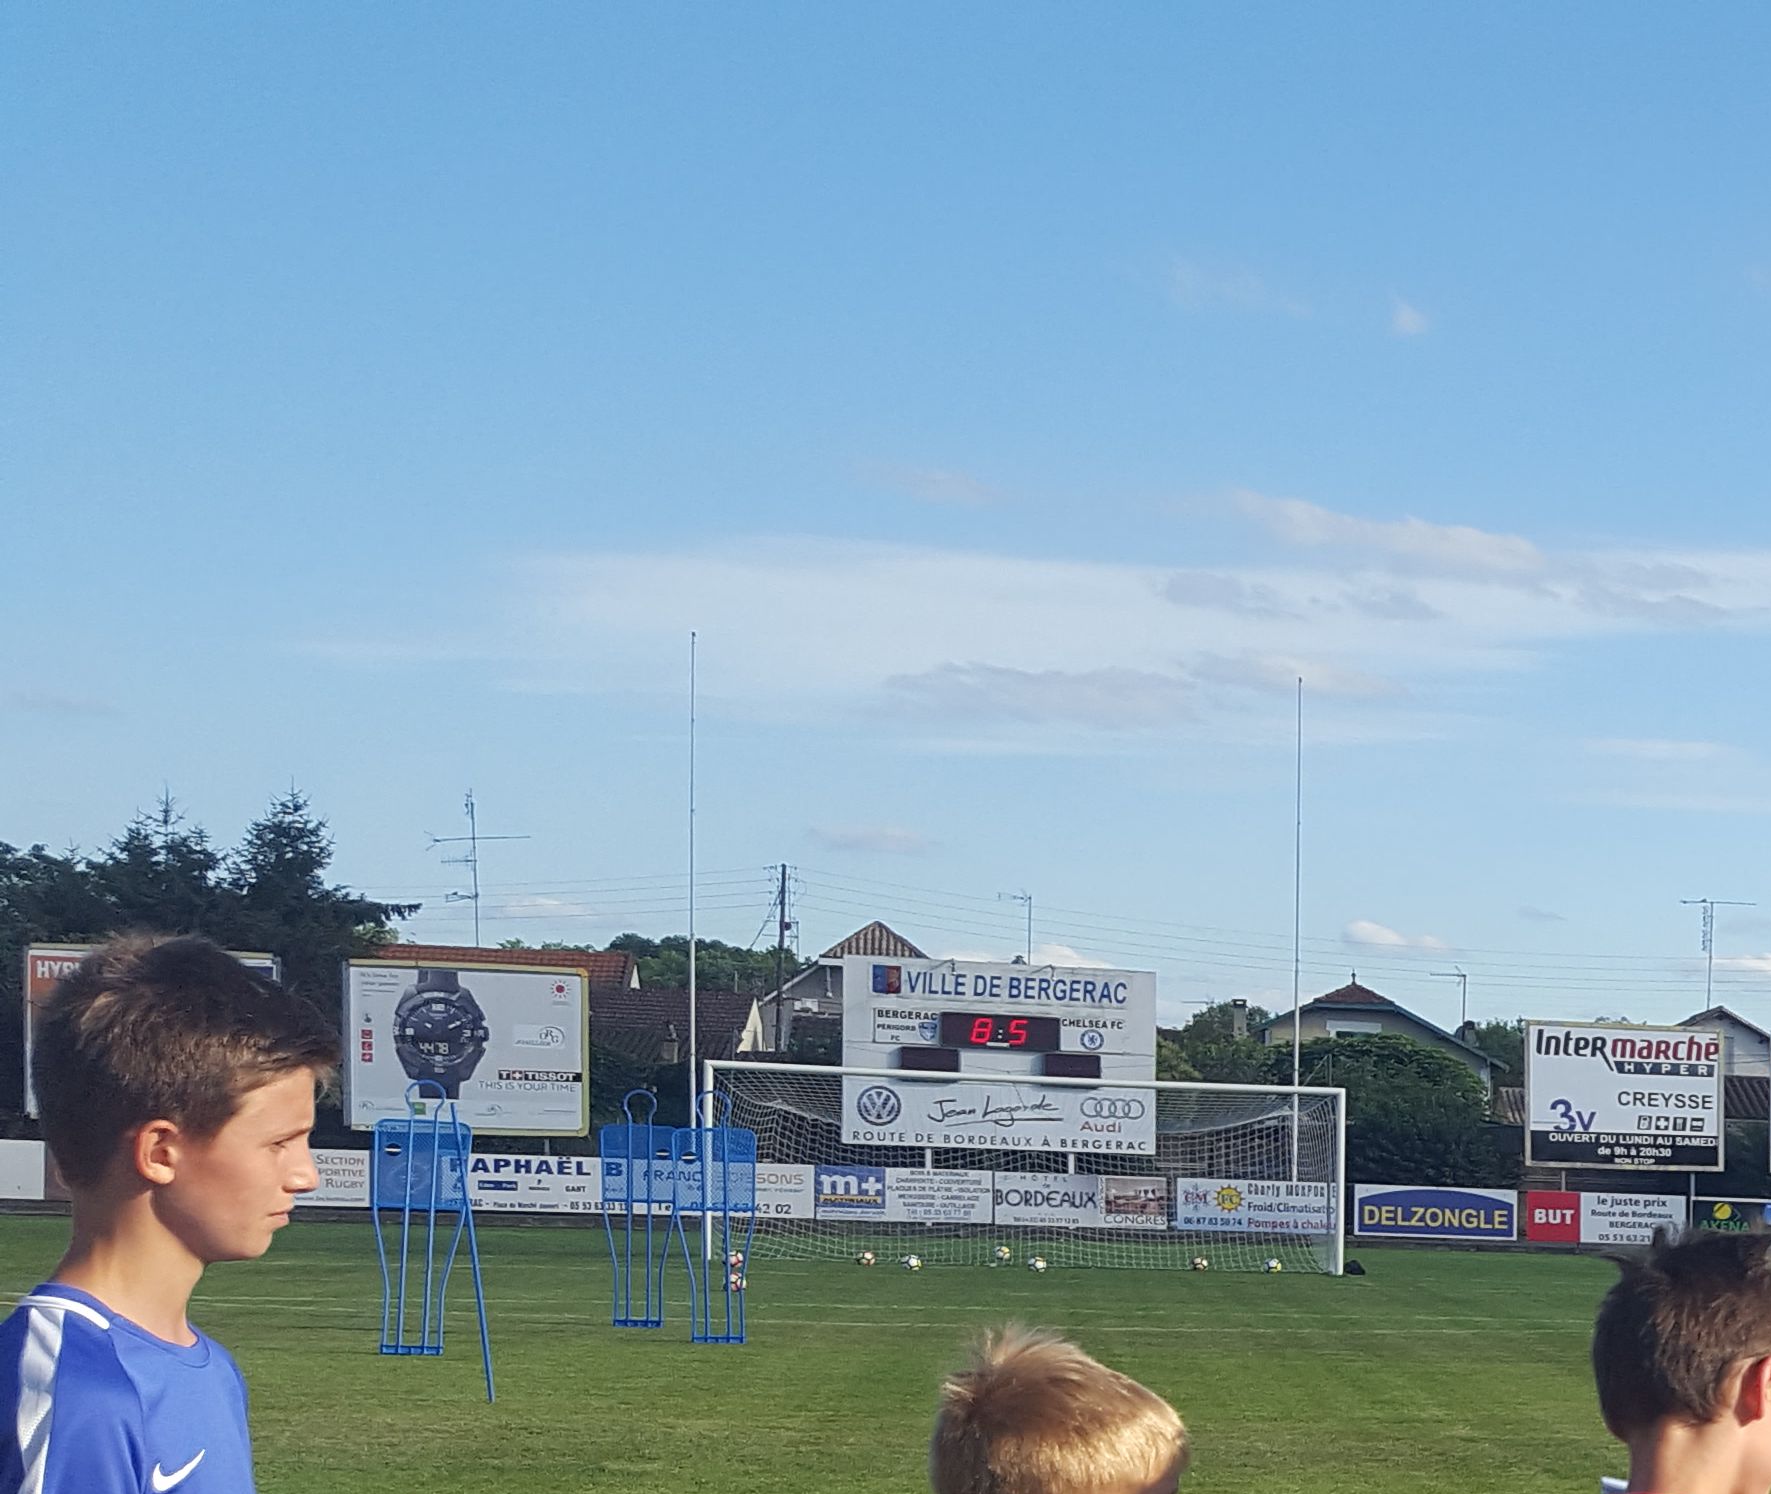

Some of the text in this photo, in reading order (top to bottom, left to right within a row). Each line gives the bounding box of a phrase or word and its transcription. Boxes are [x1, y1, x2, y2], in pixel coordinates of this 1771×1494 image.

[907, 971, 1128, 1004] VILLE DE BERGERAC
[877, 1009, 938, 1021] BERGERAC
[1062, 1018, 1124, 1030] CHELSEA FC
[1624, 1062, 1708, 1076] HYPER
[526, 1071, 577, 1081] TISSOT
[479, 1080, 576, 1092] THIS IS YOUR TIME
[1617, 1090, 1714, 1110] CREYSSE
[1080, 1120, 1122, 1133] Audi
[853, 1131, 906, 1143] ROUTE
[915, 1132, 935, 1144] DE
[943, 1133, 1033, 1147] BORDEAUX
[1060, 1138, 1147, 1151] BERGERAC
[1549, 1132, 1598, 1144] OUVERT
[1600, 1134, 1616, 1144] DU
[1619, 1135, 1654, 1145] LUNDI
[1656, 1136, 1673, 1146] AU
[1597, 1146, 1611, 1156] de
[1614, 1147, 1628, 1157] 9h
[1639, 1147, 1672, 1157] 20h30
[316, 1154, 365, 1166] SECTION
[1634, 1157, 1656, 1165] STOP
[317, 1168, 365, 1177] PORTIVE
[995, 1189, 1097, 1209] BORDEAUX
[1597, 1195, 1668, 1209] le juste prix
[775, 1203, 792, 1215] 02
[1362, 1205, 1509, 1230] DELZONGLE
[1534, 1208, 1575, 1225] BUT
[1598, 1233, 1610, 1241] 05
